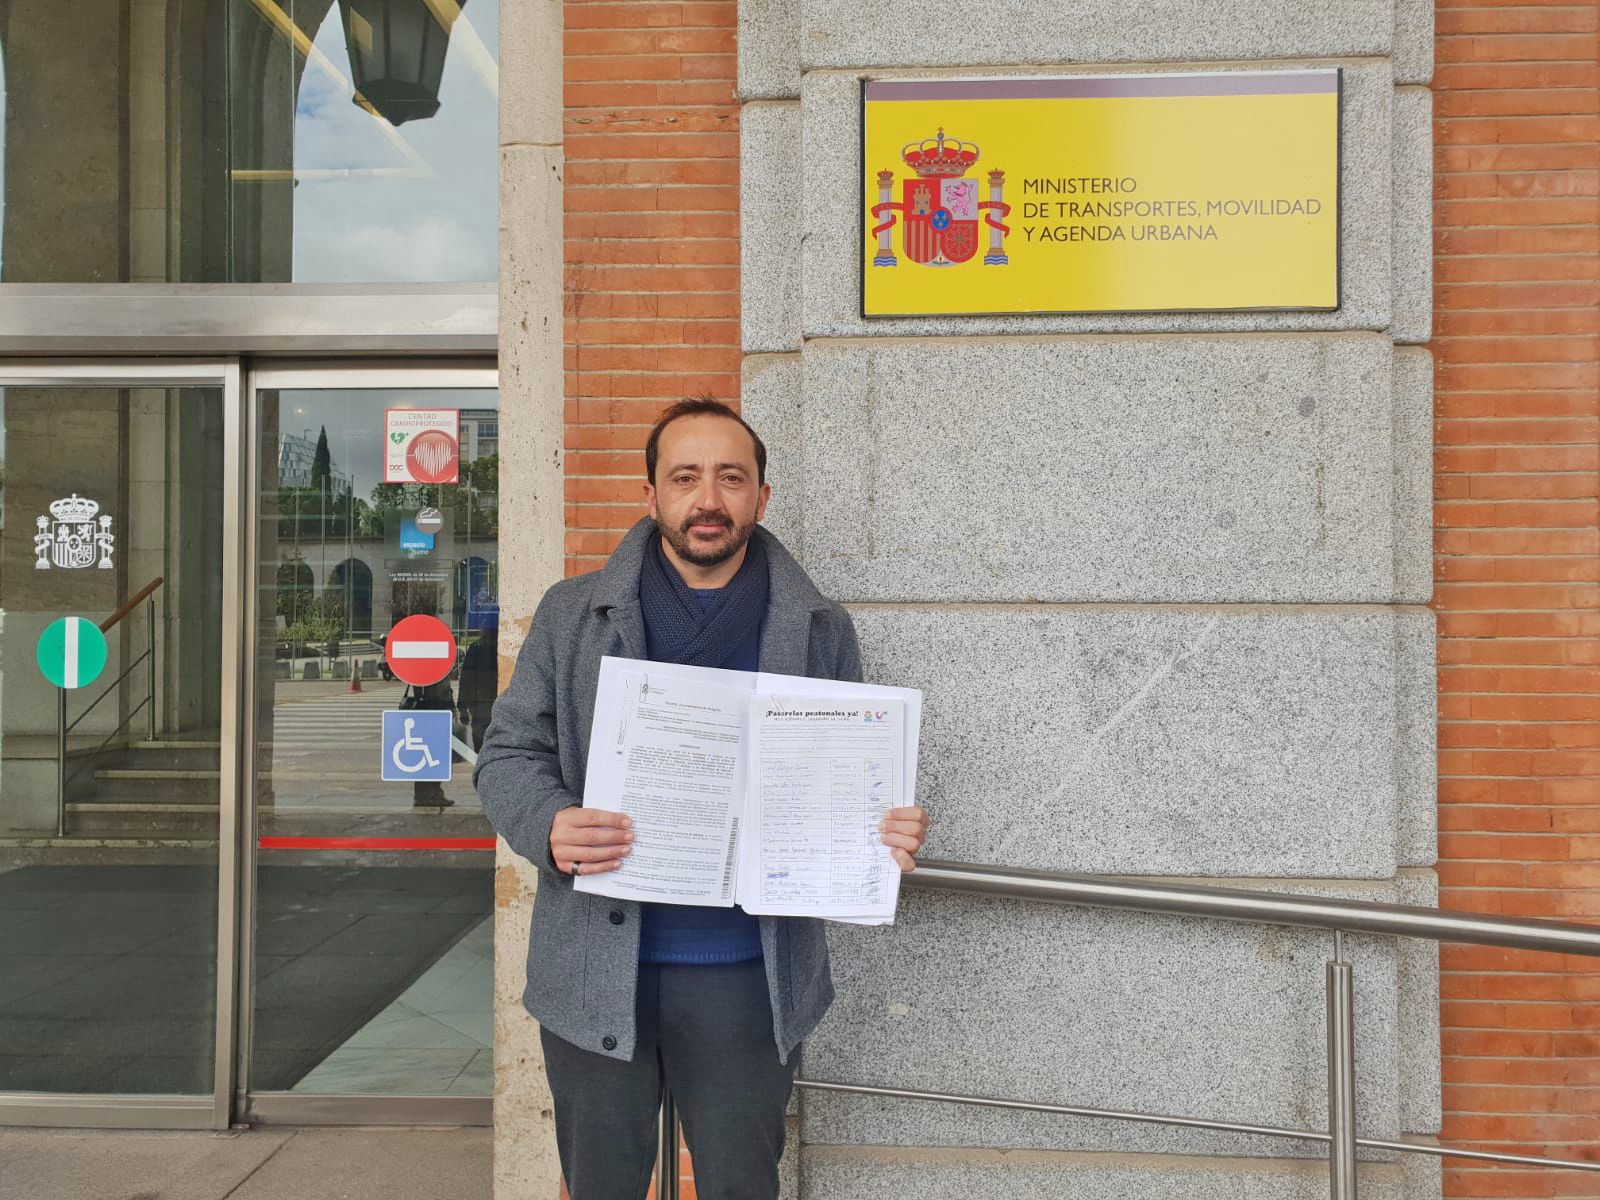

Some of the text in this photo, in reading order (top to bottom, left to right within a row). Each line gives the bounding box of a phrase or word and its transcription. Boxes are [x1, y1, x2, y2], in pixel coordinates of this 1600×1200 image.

[1023, 177, 1137, 194] MINISTERIO
[1023, 199, 1322, 218] DE TRANSPORTES, MOVILIDAD
[1023, 225, 1218, 242] Y AGENDA URBANA
[805, 709, 846, 718] peatonales
